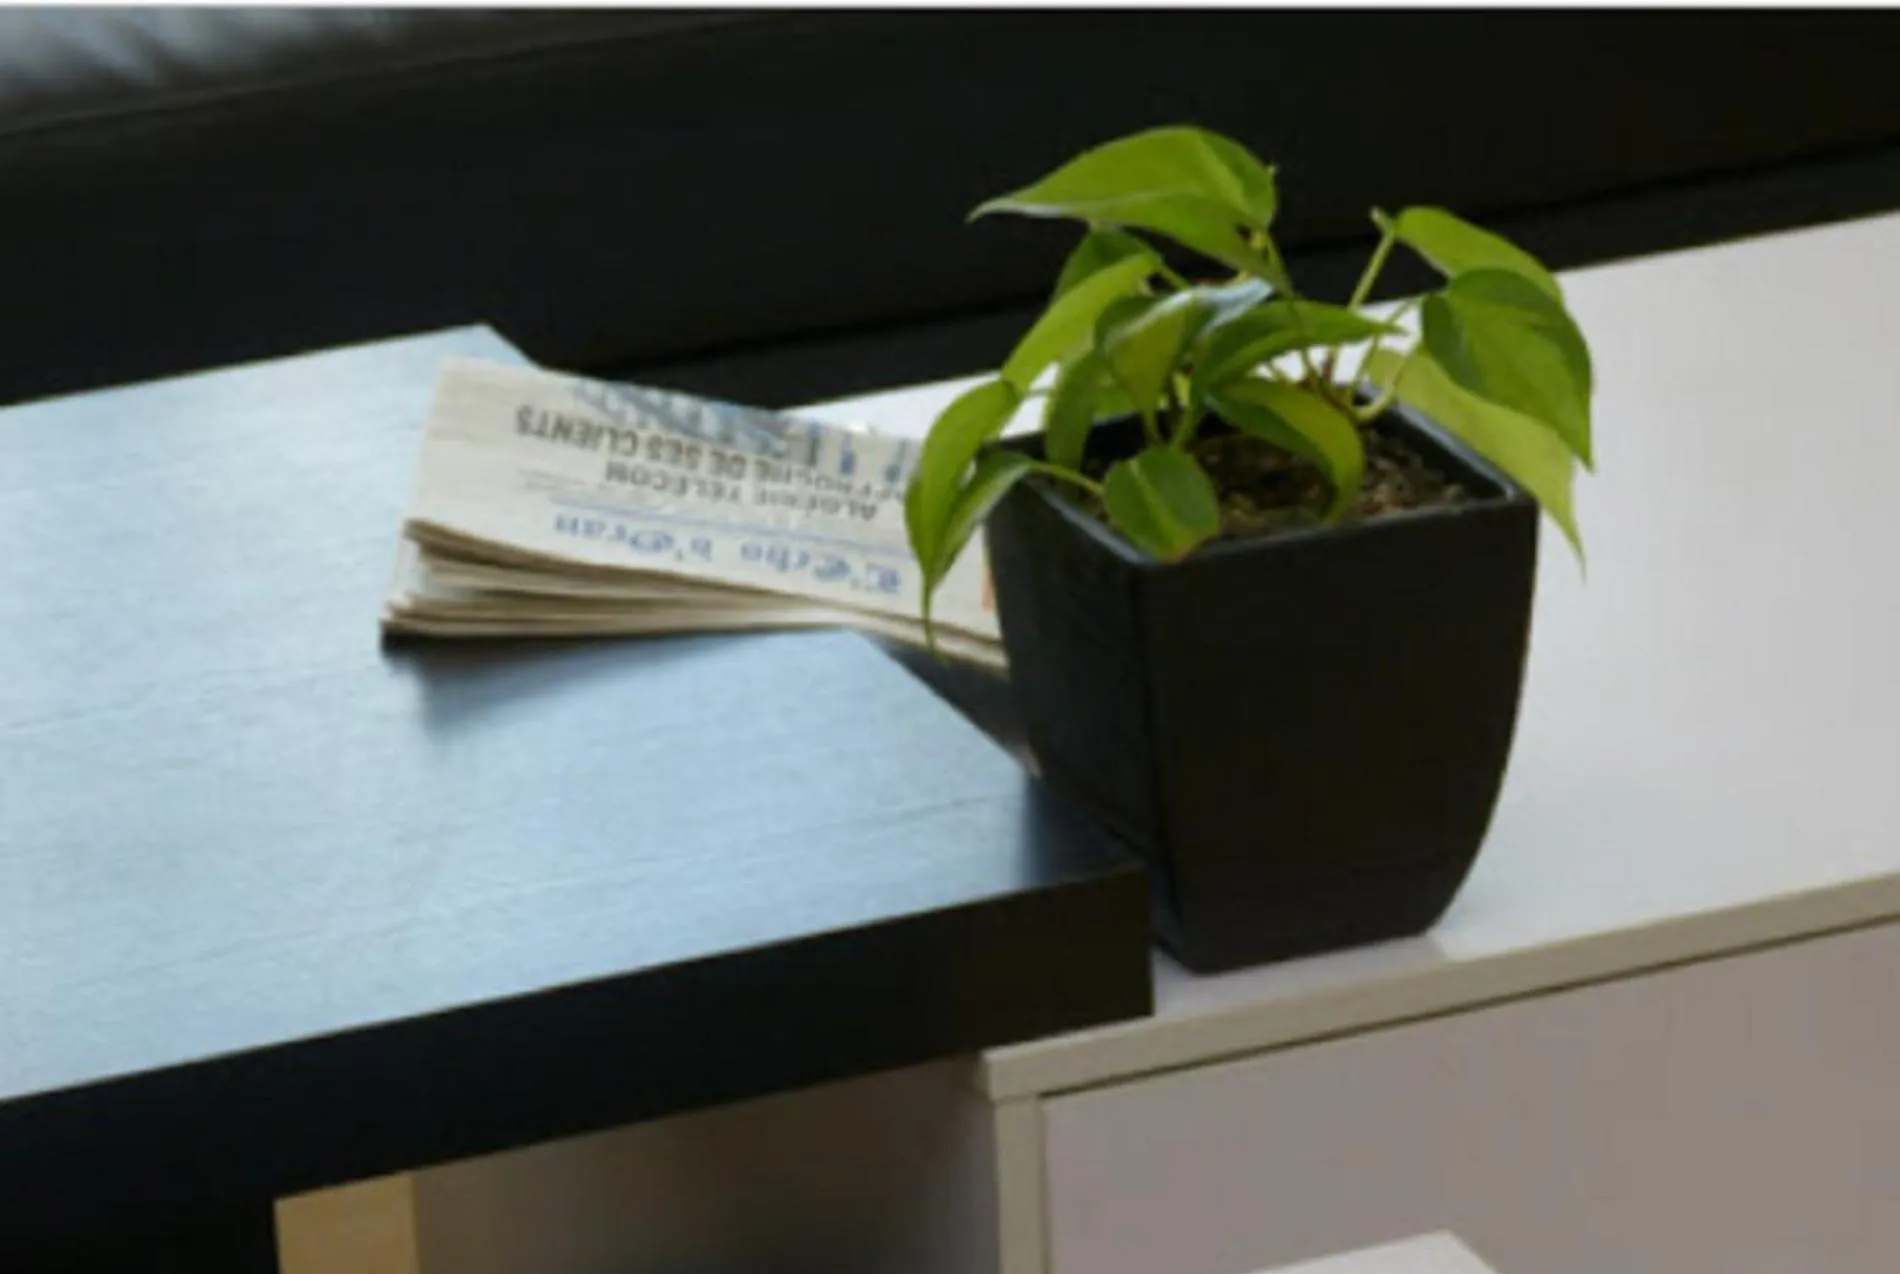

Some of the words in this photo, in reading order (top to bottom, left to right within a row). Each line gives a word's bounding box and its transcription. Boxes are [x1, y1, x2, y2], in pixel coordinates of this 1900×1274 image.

[515, 405, 639, 457] CLIENTS
[646, 434, 702, 471] SES
[708, 450, 747, 480] DE
